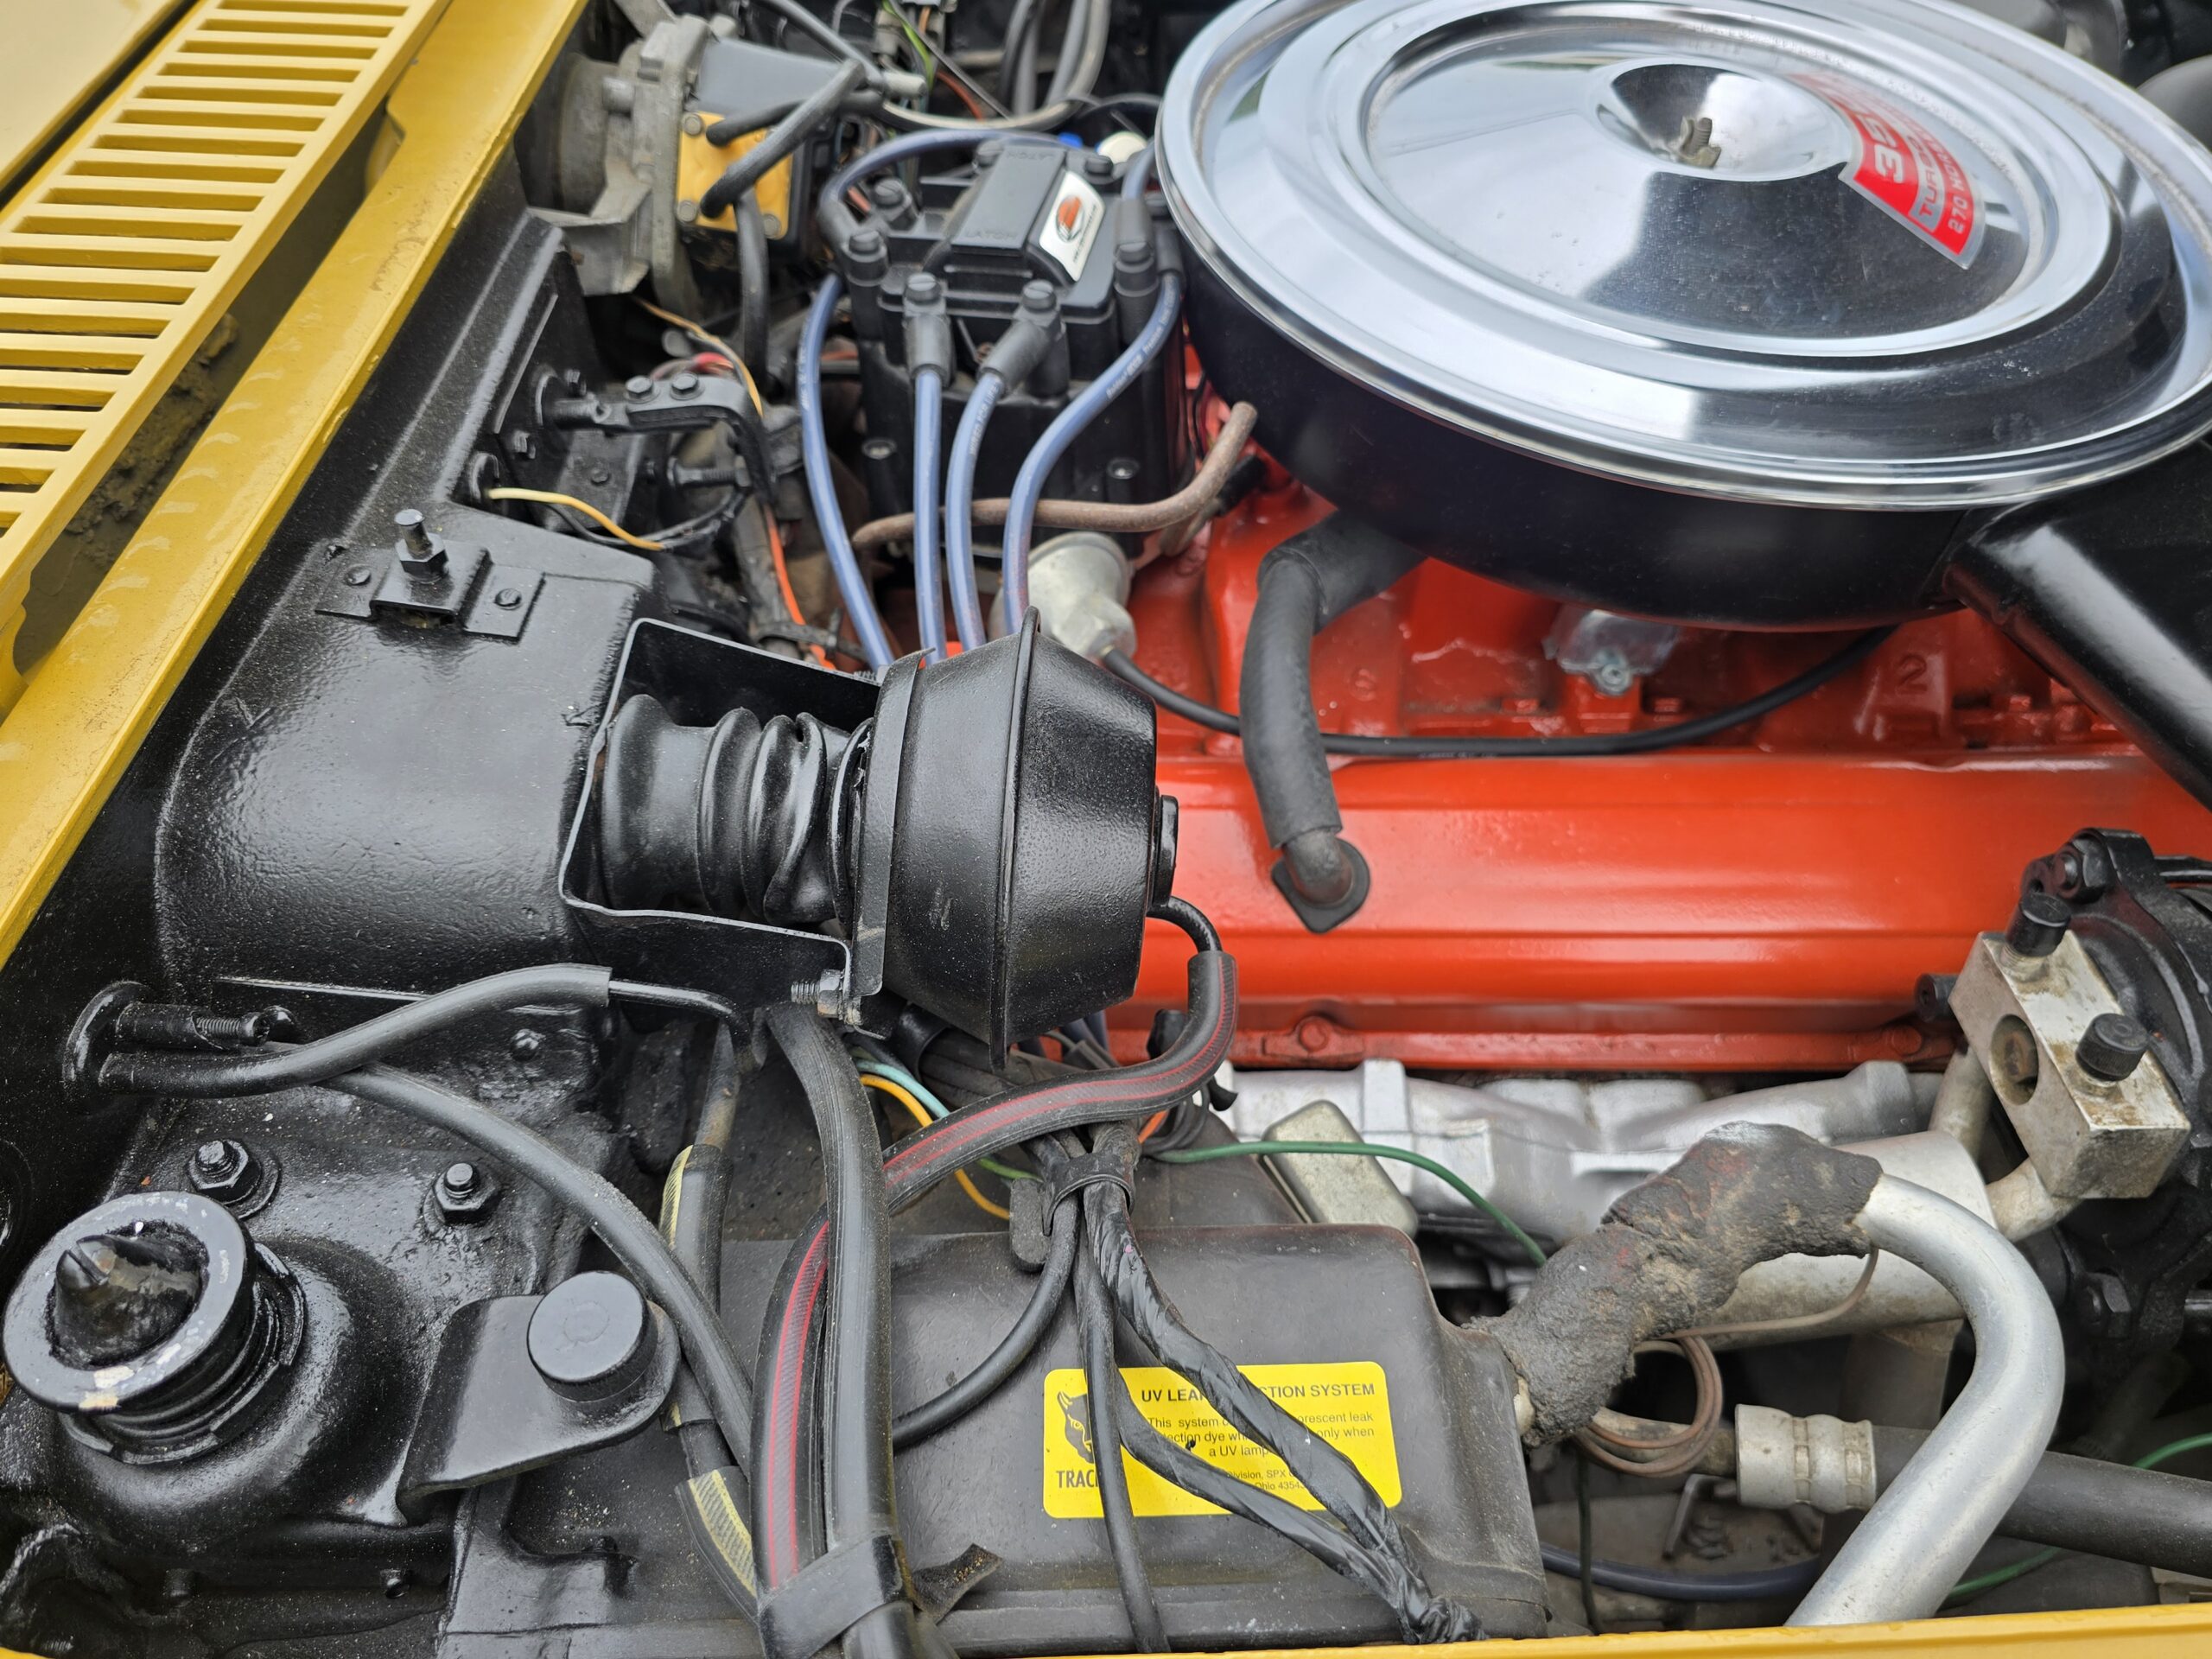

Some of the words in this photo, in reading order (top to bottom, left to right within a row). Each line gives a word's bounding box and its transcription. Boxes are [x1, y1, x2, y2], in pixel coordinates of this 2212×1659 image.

[1947, 195, 1969, 235] 270
[1141, 1389, 1163, 1402] UV
[1167, 1389, 1205, 1402] LEA
[1310, 1382, 1376, 1397] SYSTEM
[1147, 1417, 1172, 1428] This
[1178, 1418, 1219, 1430] system
[1297, 1413, 1346, 1423] orescent
[1349, 1411, 1374, 1422] leak
[1165, 1431, 1201, 1443] ection
[1204, 1430, 1225, 1445] dye
[1343, 1426, 1375, 1438] when
[1209, 1447, 1217, 1458] a
[1219, 1445, 1237, 1457] UV
[1266, 1469, 1287, 1478] SPX
